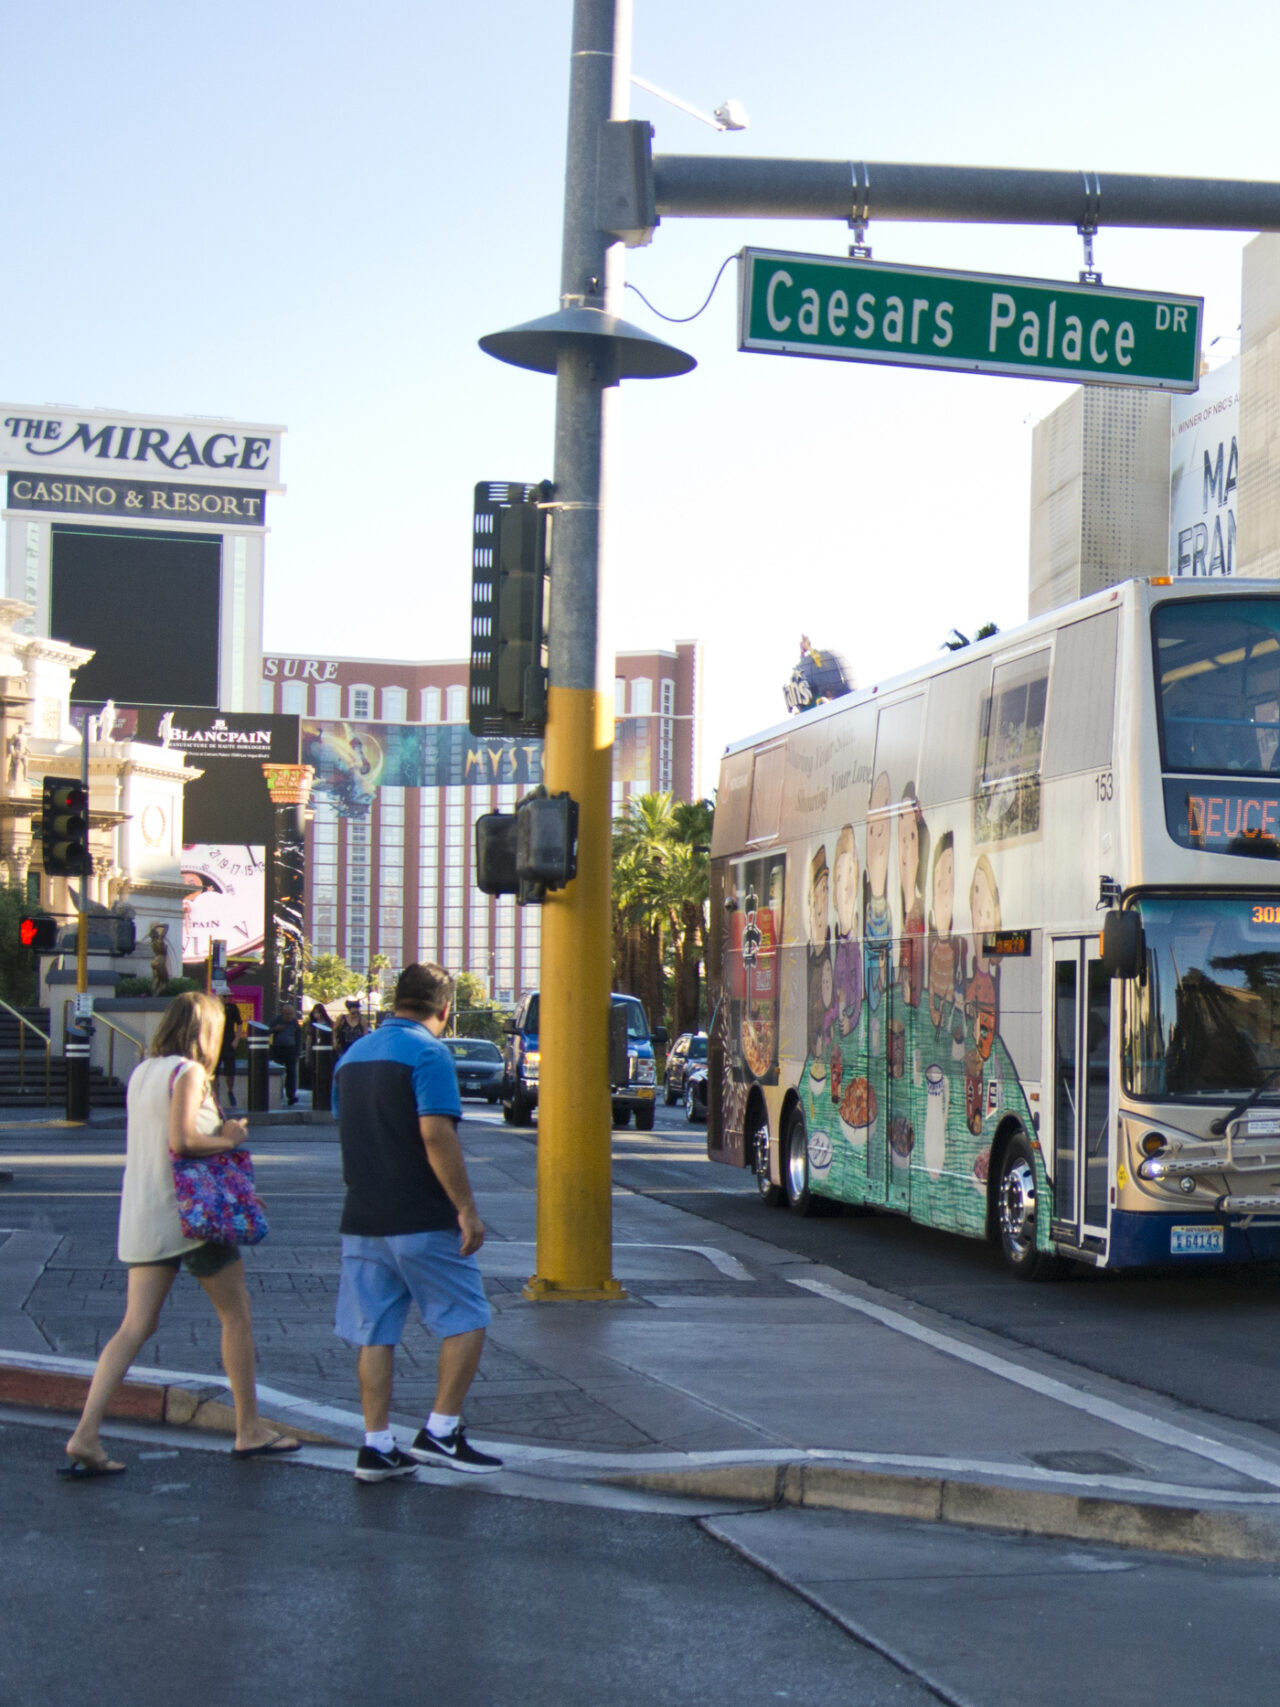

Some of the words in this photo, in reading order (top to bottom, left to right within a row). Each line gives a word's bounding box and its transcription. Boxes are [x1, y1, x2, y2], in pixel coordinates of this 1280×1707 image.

[766, 269, 954, 348] Caesars
[989, 292, 1135, 366] Palace
[1155, 304, 1189, 333] DR
[1203, 406, 1212, 420] OF
[4, 417, 62, 440] THE
[26, 422, 271, 470] MIRAGE
[13, 480, 116, 505] CASINO
[125, 490, 143, 508] &
[151, 490, 260, 516] RESORT
[264, 658, 339, 681] SURE
[170, 728, 272, 743] BLANCPAIN
[464, 746, 545, 778] MYST
[1095, 772, 1113, 801] 153
[1188, 796, 1279, 839] DEUCE
